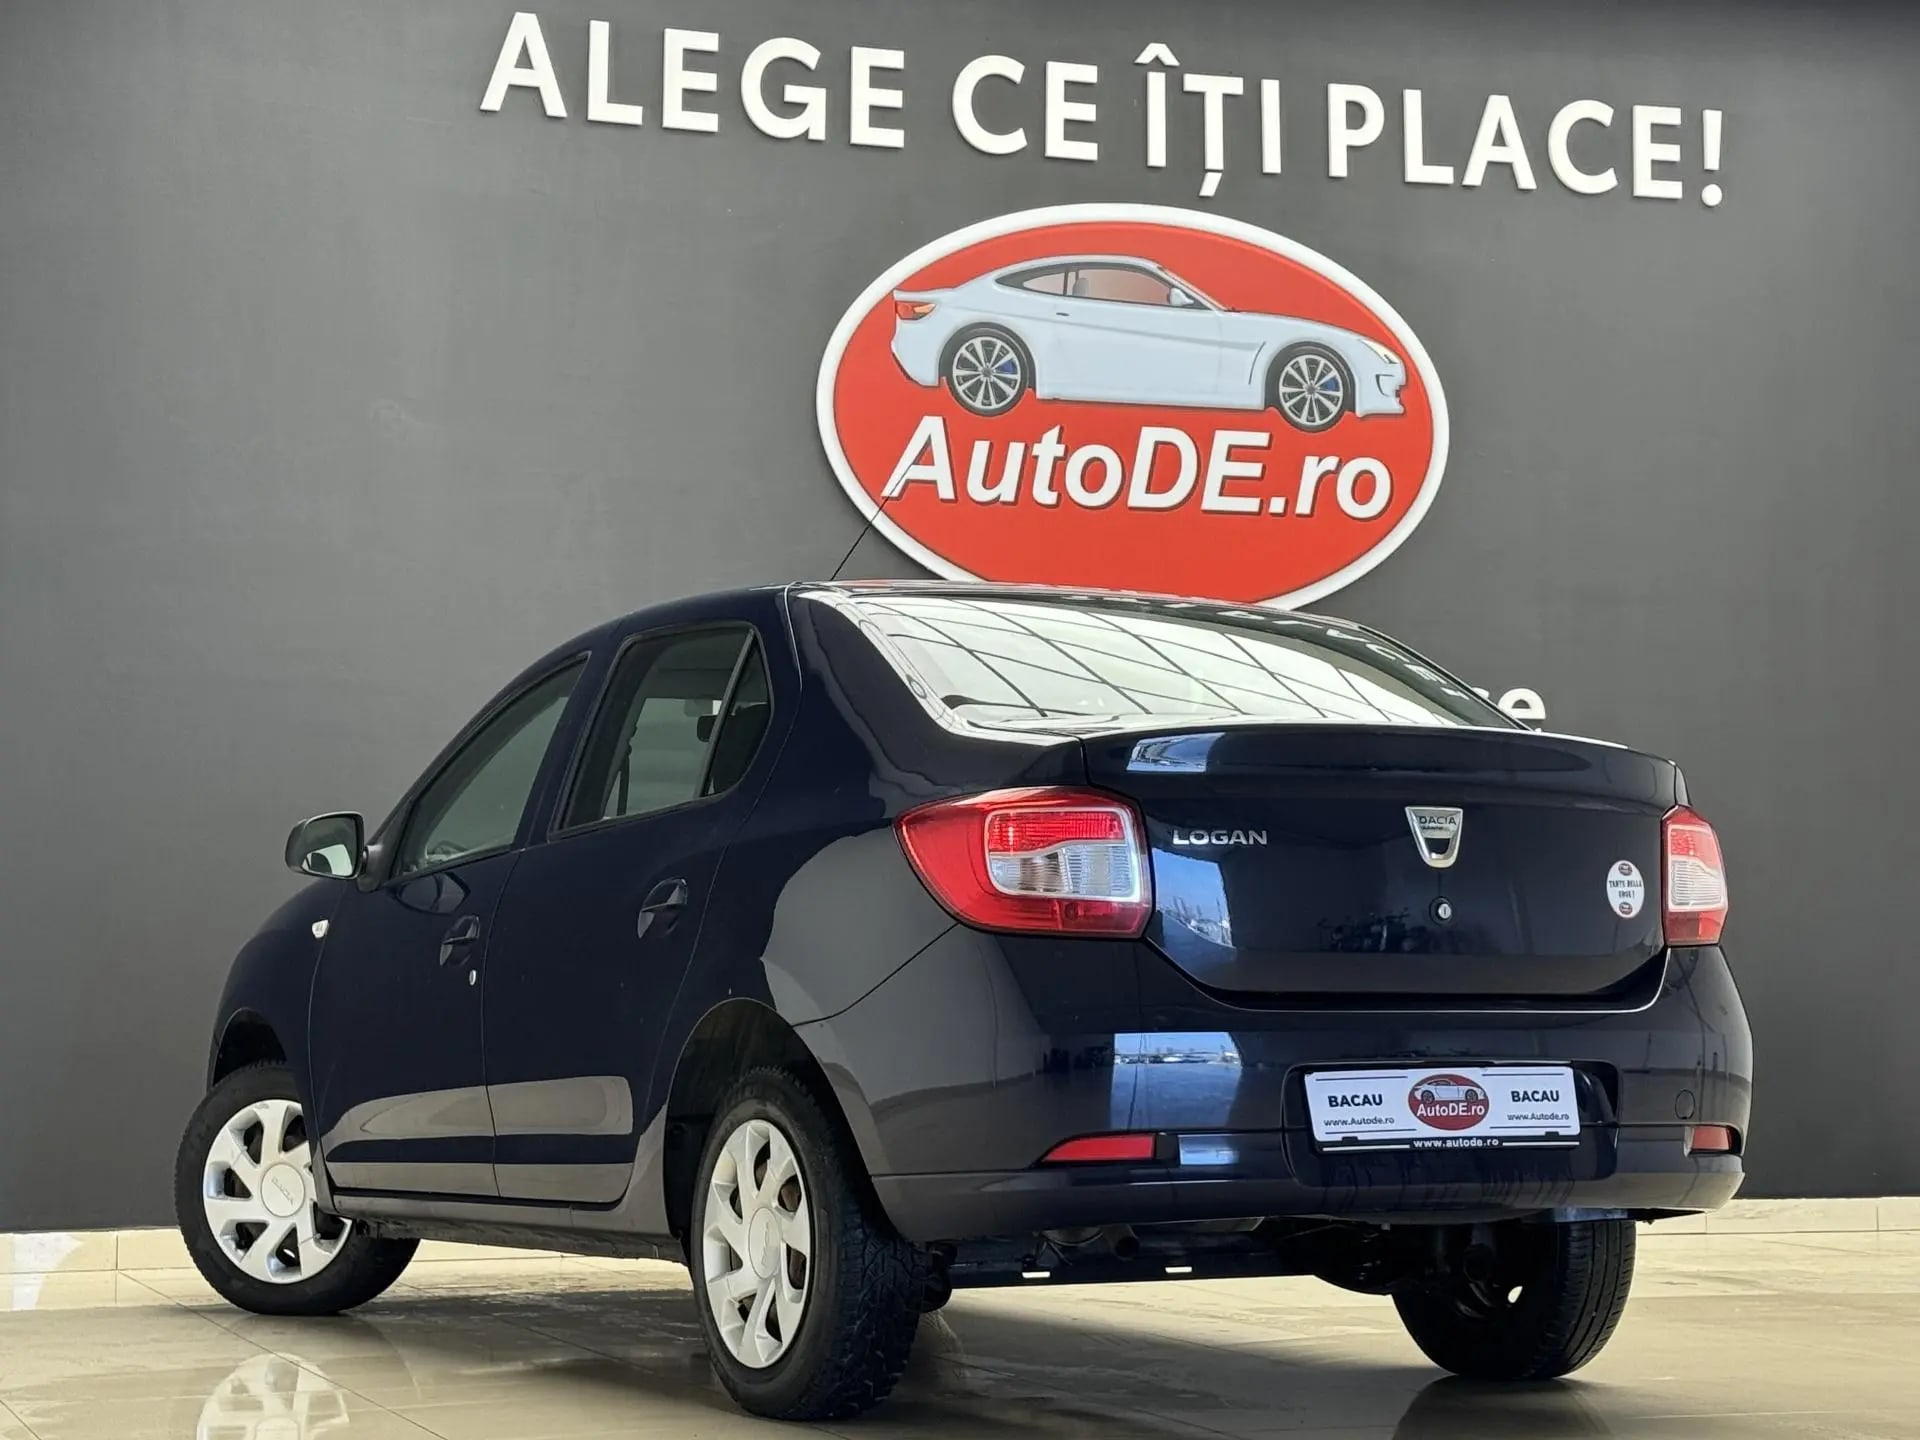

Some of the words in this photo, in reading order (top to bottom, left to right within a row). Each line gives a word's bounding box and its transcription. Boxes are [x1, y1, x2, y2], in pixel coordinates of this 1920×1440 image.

[480, 11, 904, 148] ALEGE
[952, 54, 1099, 162] CE
[1134, 42, 1281, 197] ÎȚI
[1328, 82, 1723, 207] PLACE!
[880, 414, 1394, 520] AutoDE.ro
[1419, 815, 1456, 825] DACIA
[1172, 829, 1268, 845] LOGAN
[1327, 1093, 1383, 1107] BACAU
[1510, 1090, 1560, 1102] BACAU
[1416, 1102, 1486, 1117] AutoDE.ro
[1324, 1115, 1395, 1126] www.Autode.ro
[1413, 1136, 1500, 1148] www.autode.ro
